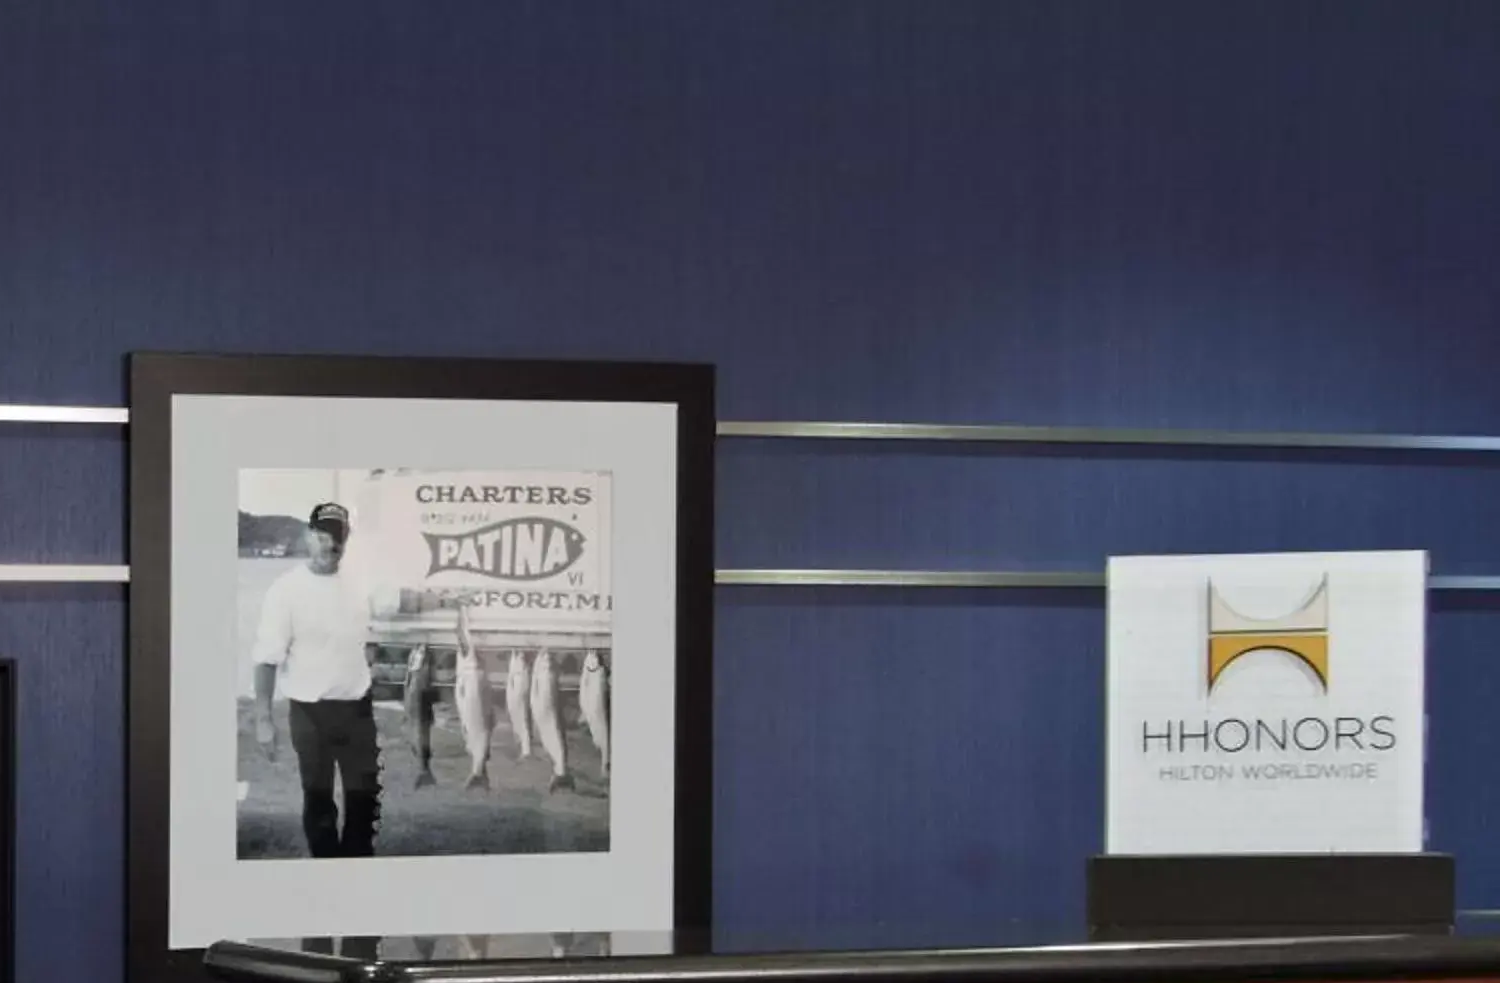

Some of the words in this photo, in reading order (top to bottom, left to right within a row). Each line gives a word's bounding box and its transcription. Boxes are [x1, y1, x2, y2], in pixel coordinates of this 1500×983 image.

[415, 485, 593, 505] CHARTERS
[438, 522, 570, 577] PATINA
[1142, 715, 1398, 754] HHONORS
[1159, 764, 1234, 782] HILTON
[1241, 762, 1379, 781] WORLDWIDE
